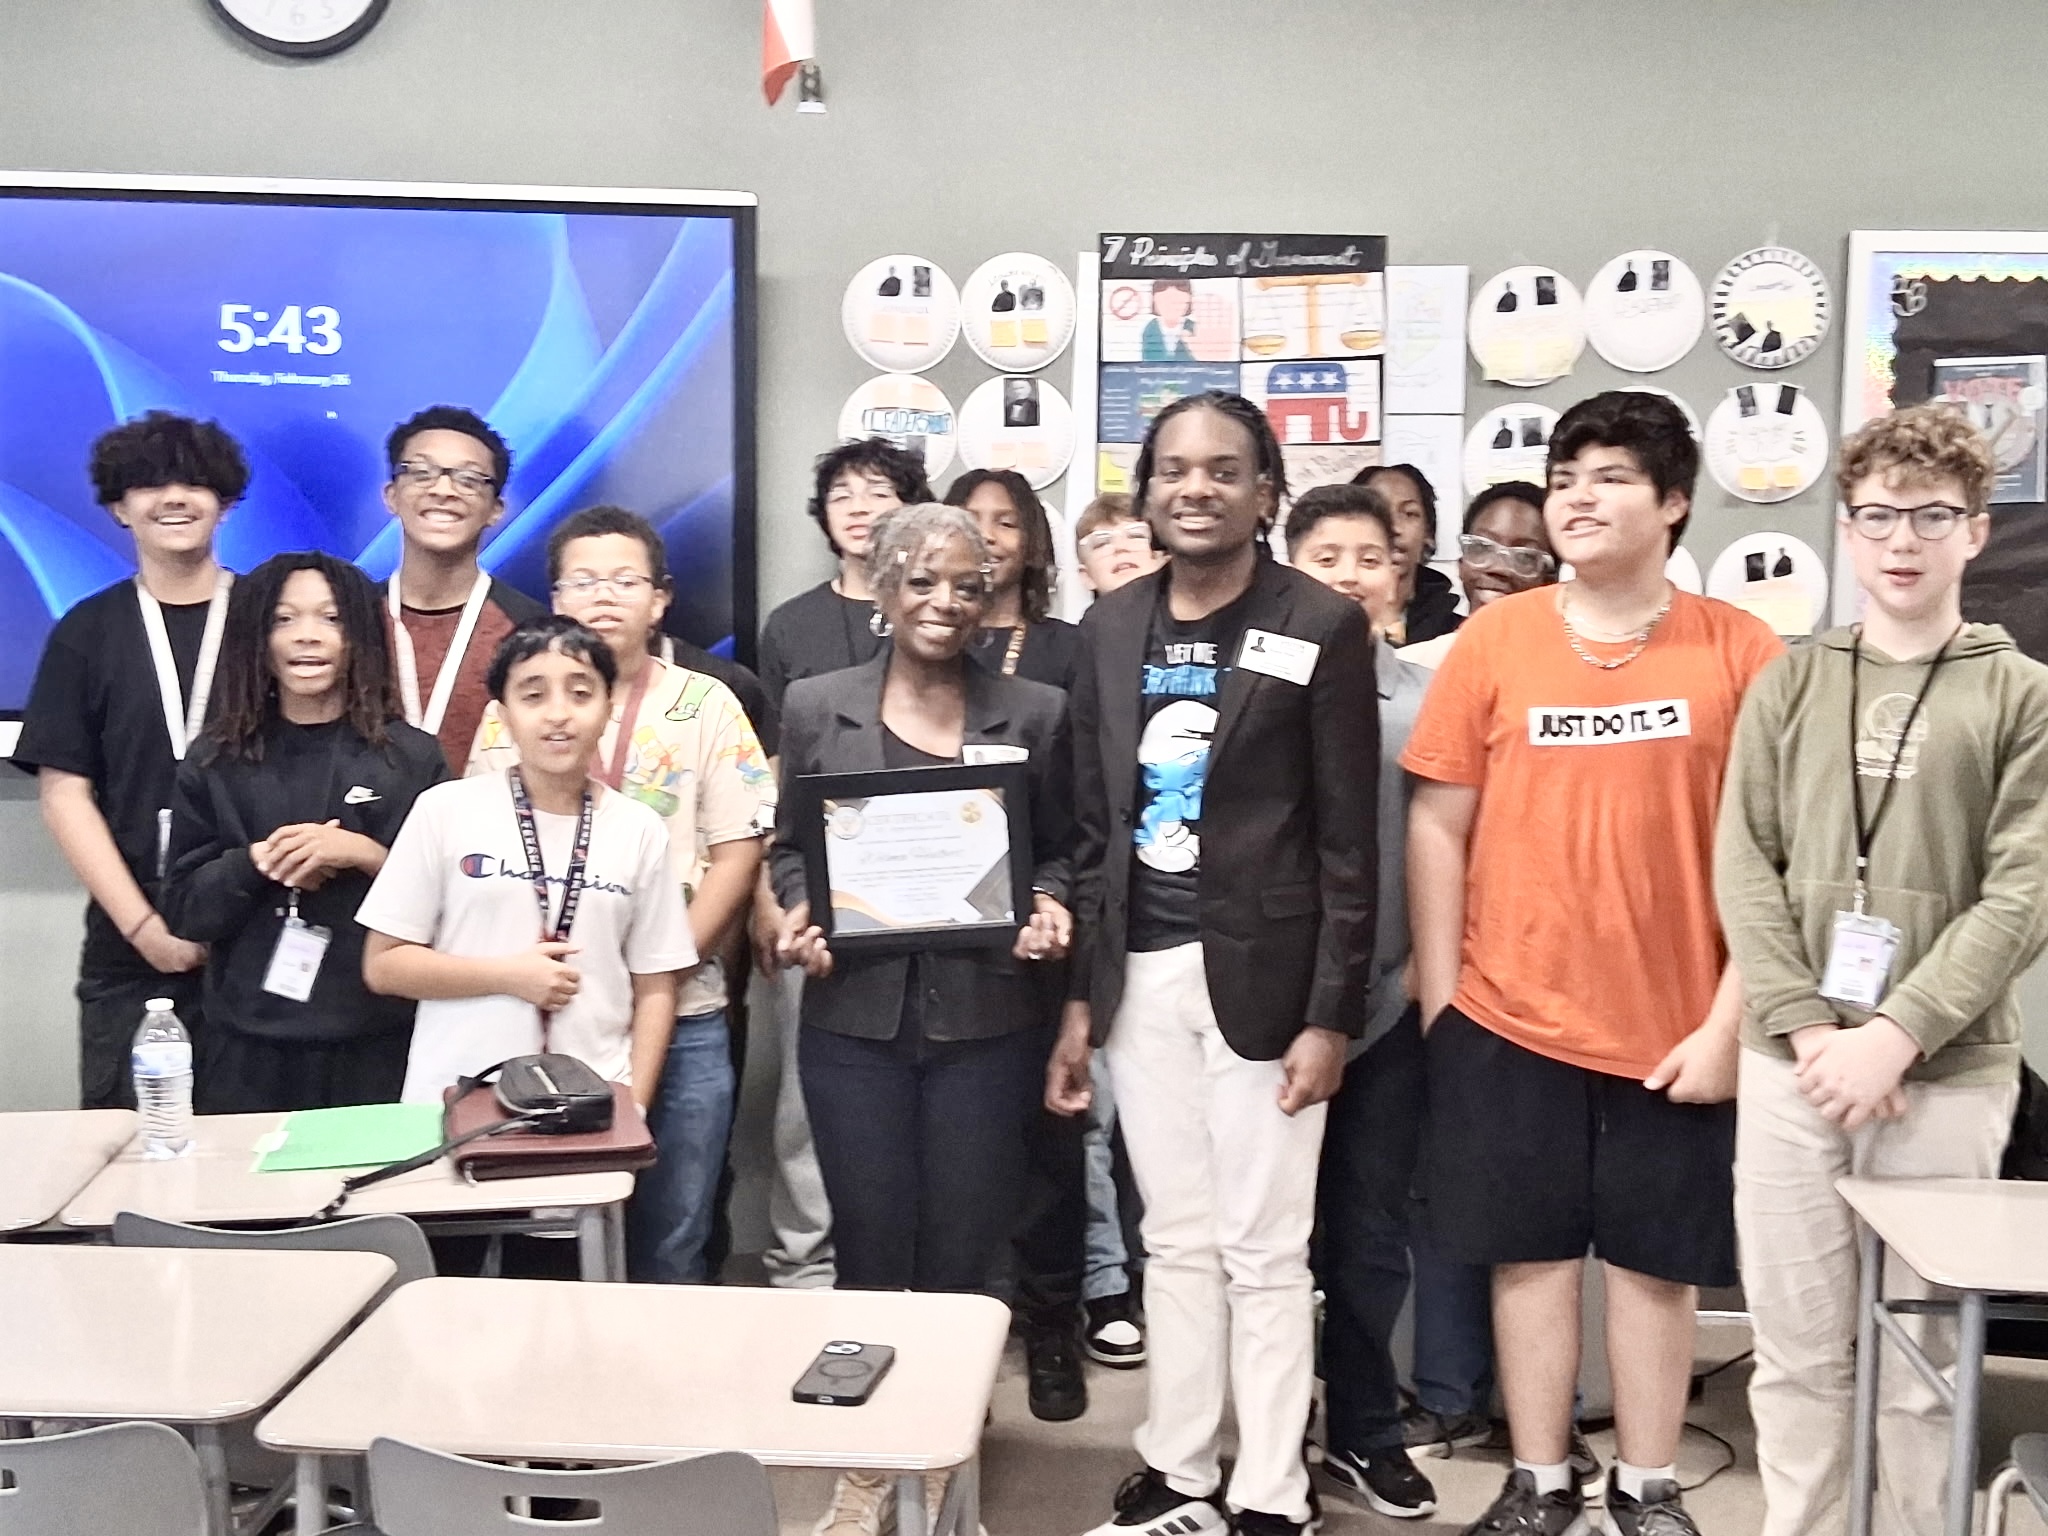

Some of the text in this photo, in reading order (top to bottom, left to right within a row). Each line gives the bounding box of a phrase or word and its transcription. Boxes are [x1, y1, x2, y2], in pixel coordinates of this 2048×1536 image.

[1101, 235, 1126, 263] 7
[1226, 241, 1251, 274] of
[217, 303, 343, 356] 5:43
[1539, 714, 1587, 737] JUST
[1593, 714, 1626, 737] DO
